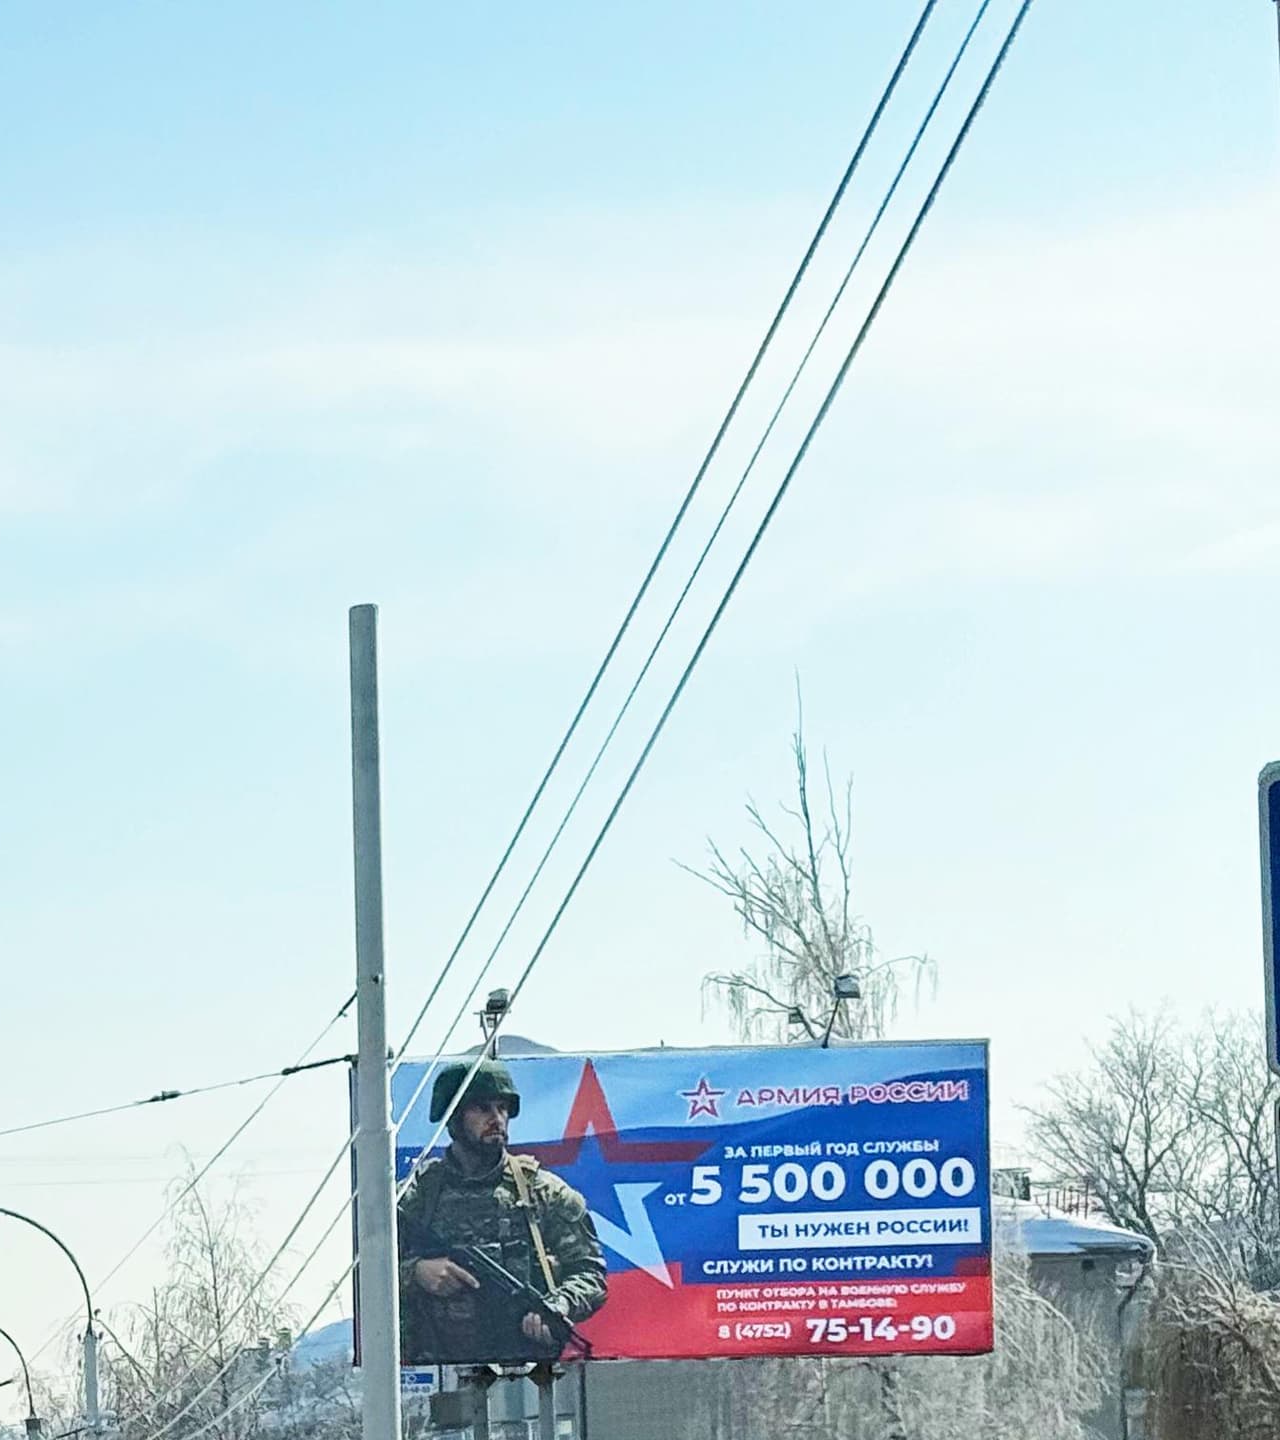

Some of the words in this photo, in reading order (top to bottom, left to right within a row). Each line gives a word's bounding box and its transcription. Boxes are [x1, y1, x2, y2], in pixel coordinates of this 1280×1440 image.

[736, 1086, 842, 1106] АРМИЯ
[850, 1080, 969, 1104] РОССИИ
[724, 1146, 747, 1159] ЗА
[750, 1141, 822, 1157] ПЕРВЫЙ
[826, 1142, 860, 1157] ГОД
[863, 1139, 939, 1154] СЛУЖБЫ
[690, 1164, 722, 1205] 5
[739, 1161, 846, 1203] 500
[864, 1157, 976, 1199] 000
[757, 1224, 789, 1238] ТЫ
[795, 1222, 870, 1237] НУЖЕН
[878, 1219, 969, 1234] РОССИИ!
[702, 1258, 773, 1275] СЛУЖИ
[779, 1257, 807, 1273] ПО
[812, 1254, 933, 1272] КОНТРАКТУ!
[716, 1288, 762, 1300] ПУНКТ
[763, 1287, 816, 1298] ОТБОРА
[819, 1286, 839, 1297] НА
[840, 1284, 908, 1296] ВОЕННУЮ
[911, 1282, 966, 1294] СЛУЖБУ
[717, 1302, 737, 1312] ПО
[739, 1300, 816, 1311] КОНТРАКТУ
[818, 1299, 827, 1309] В
[718, 1324, 730, 1339] 8
[735, 1321, 791, 1340] (4752)
[806, 1315, 956, 1342] 75-14-90
